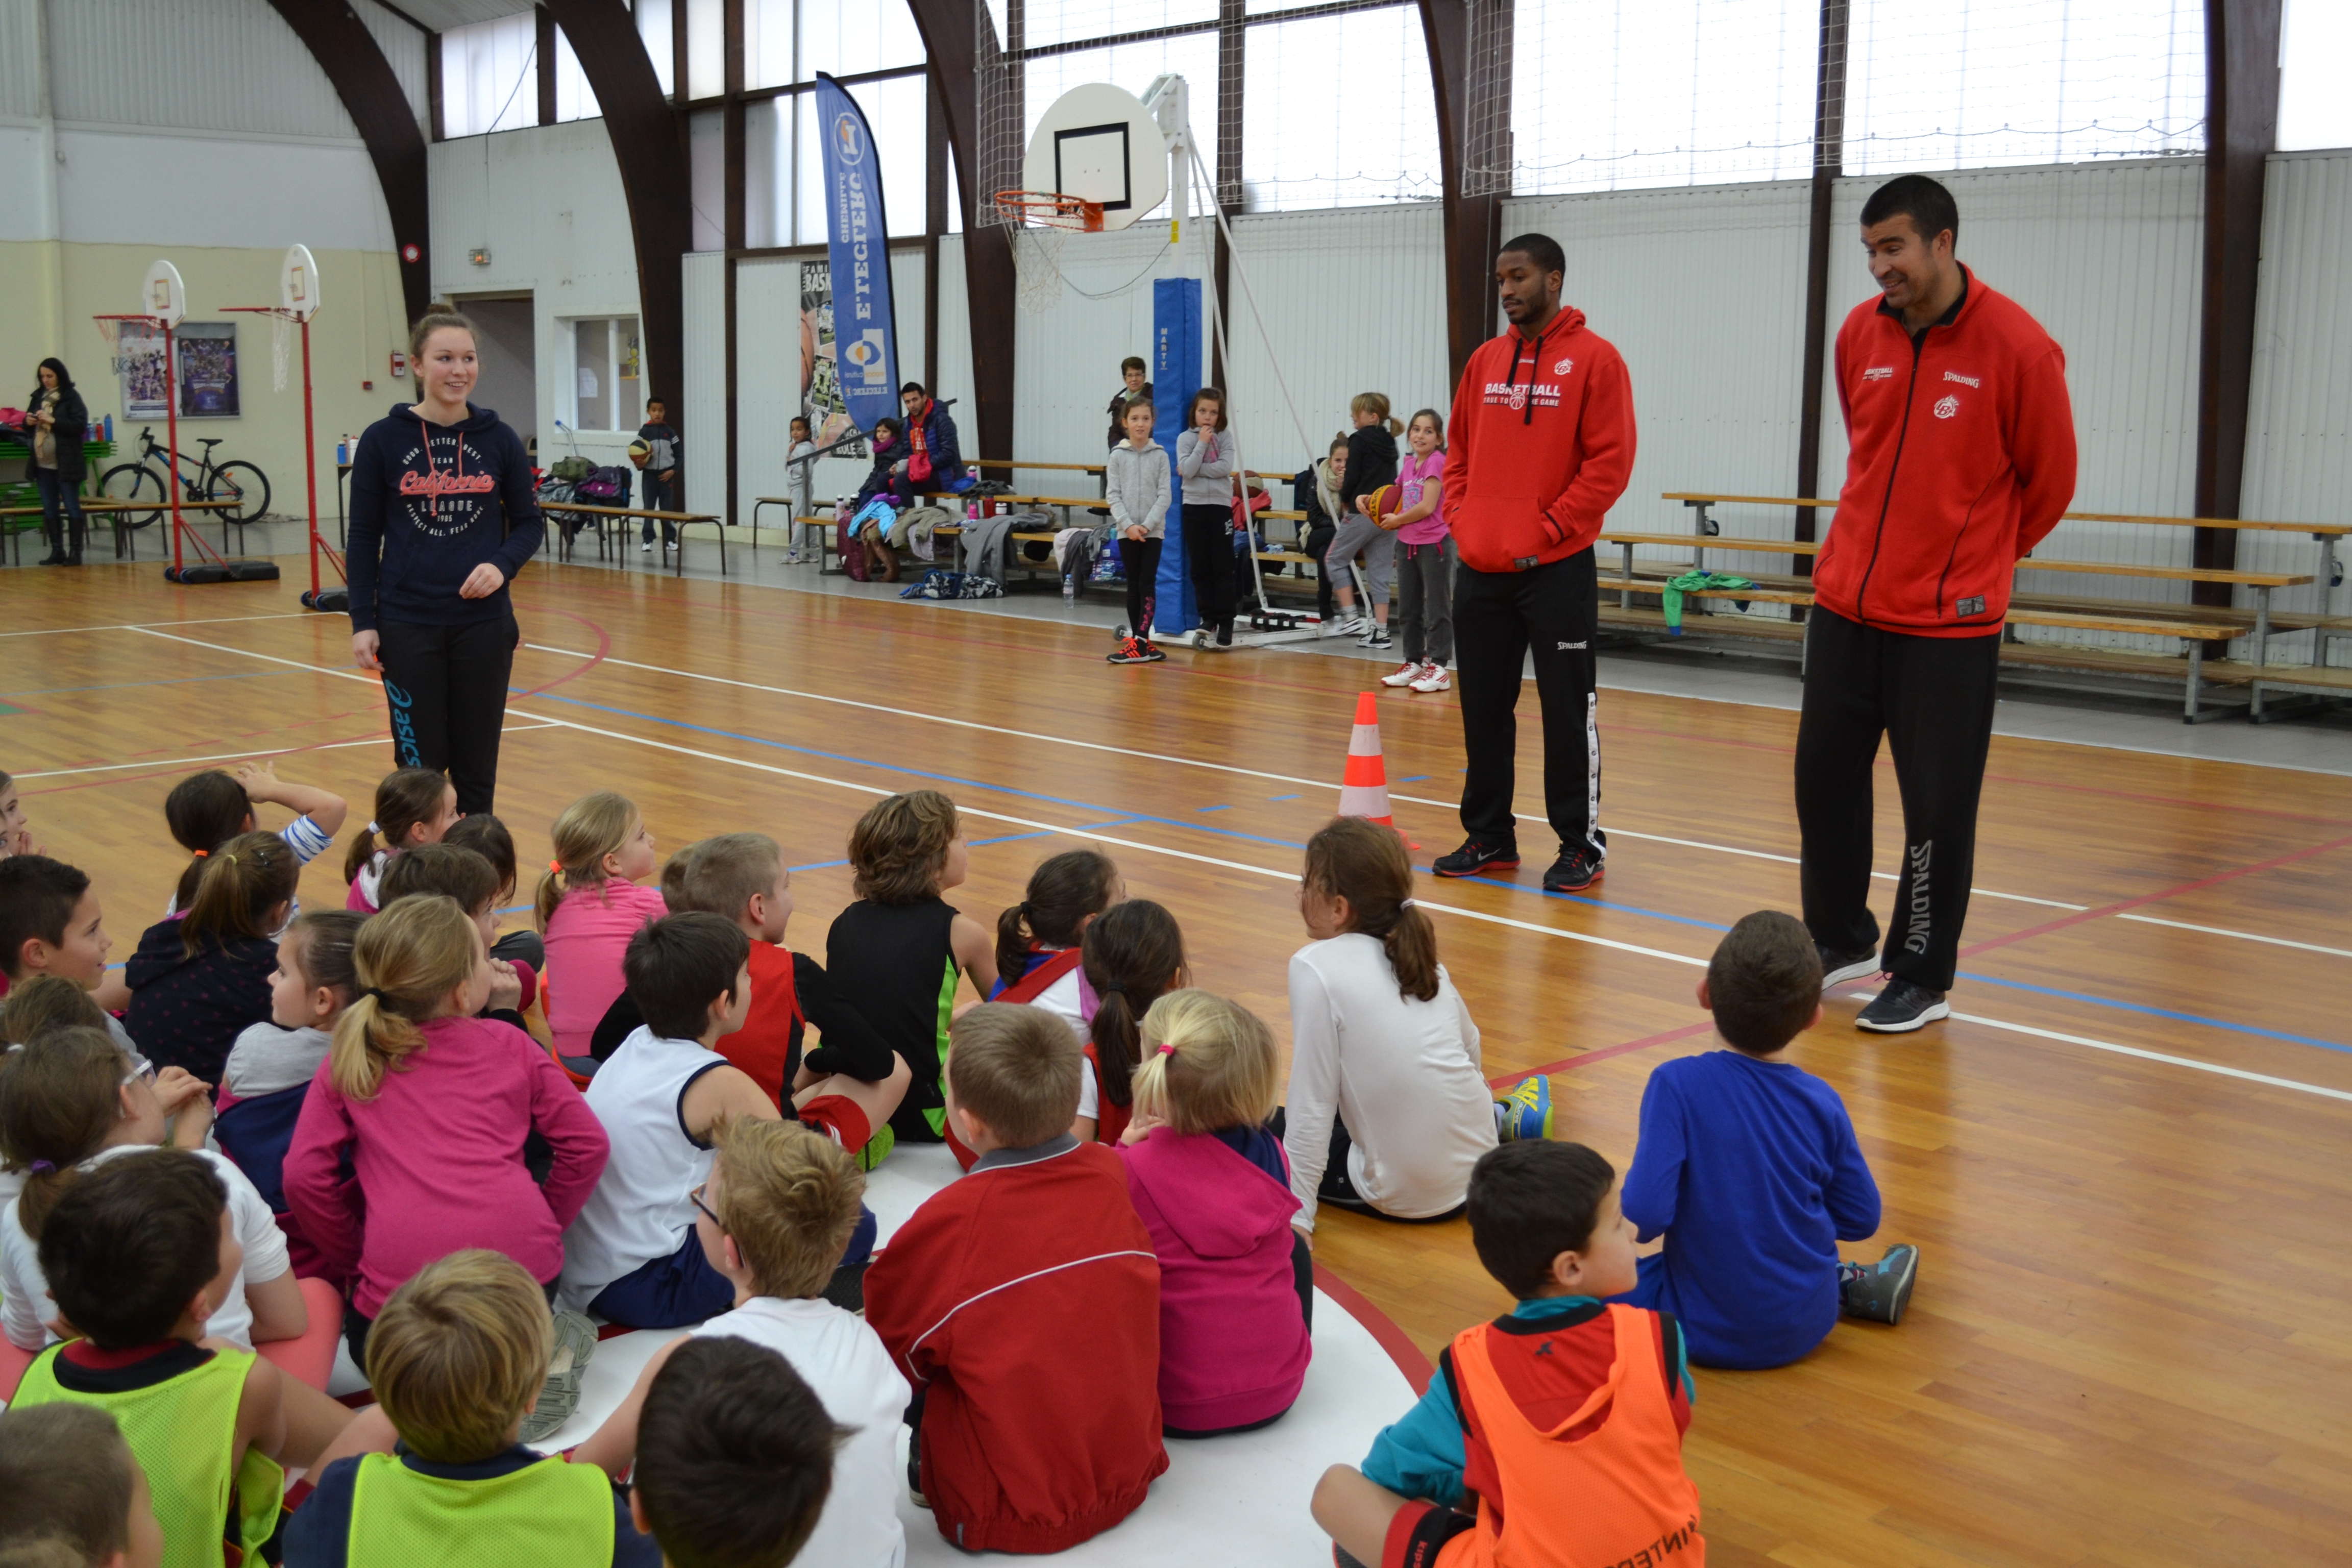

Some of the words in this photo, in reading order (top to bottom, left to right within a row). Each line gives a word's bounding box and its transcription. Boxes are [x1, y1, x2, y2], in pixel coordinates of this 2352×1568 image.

[1160, 328, 1168, 368] MARTY
[1484, 383, 1561, 397] BASKETBALL
[1943, 371, 1979, 388] SPALDING
[428, 437, 459, 447] ETTER.
[463, 444, 481, 463] BEST.
[400, 469, 495, 498] California
[406, 503, 427, 531] RESPECT
[450, 523, 468, 534] FEAR
[421, 500, 473, 512] LEAGUE
[1557, 640, 1586, 650] SPALDING
[394, 708, 422, 768] asics
[1904, 840, 1932, 954] SPALDING
